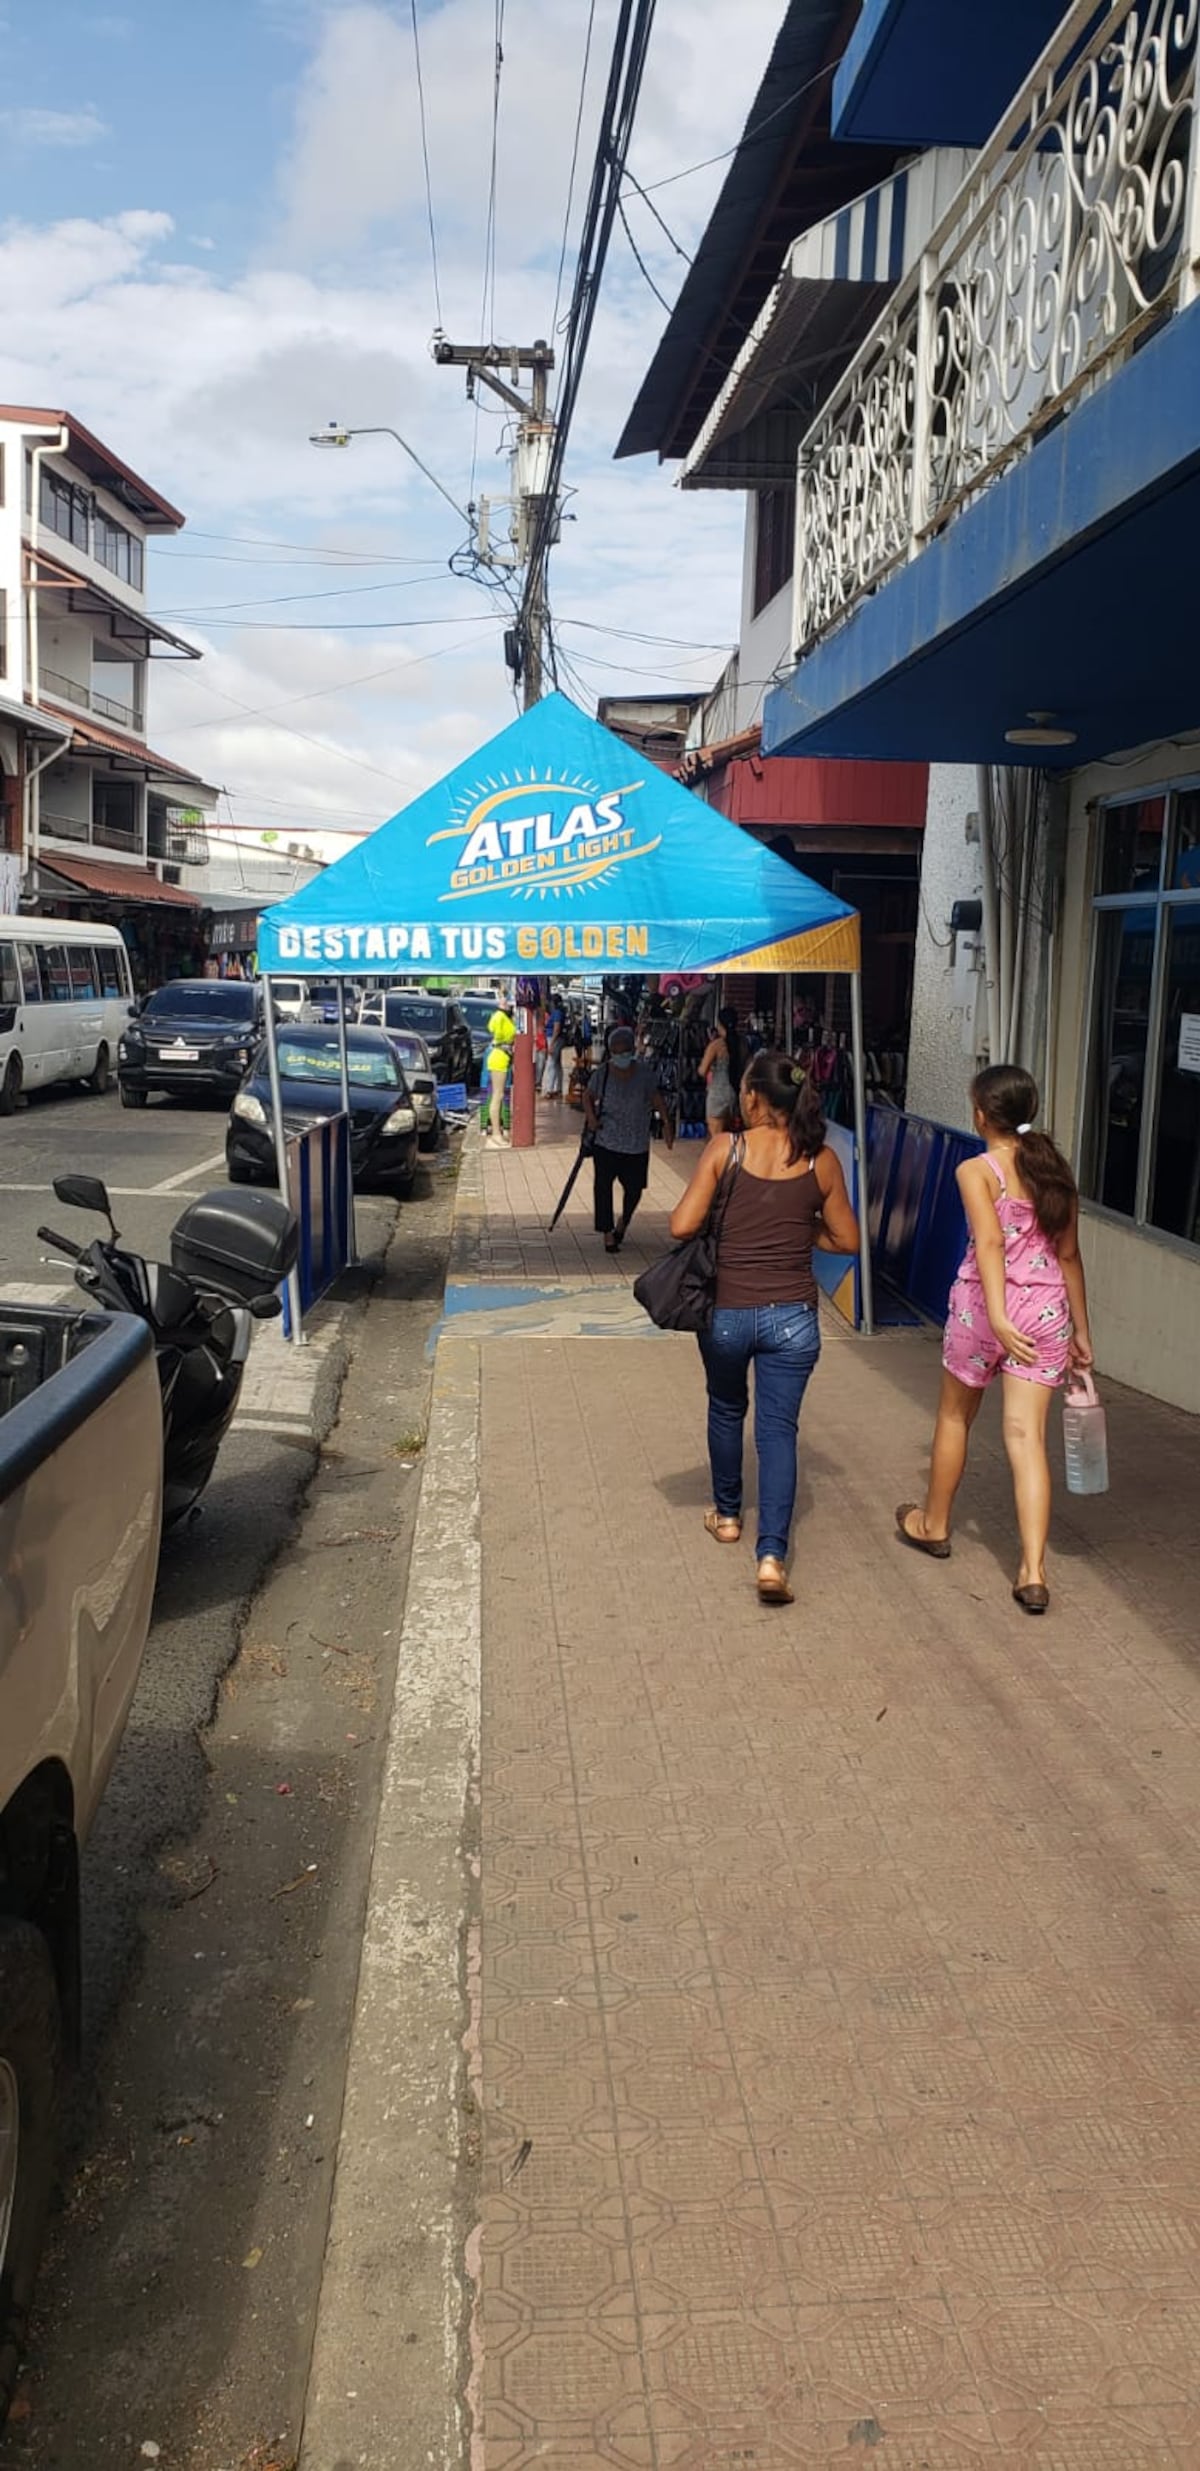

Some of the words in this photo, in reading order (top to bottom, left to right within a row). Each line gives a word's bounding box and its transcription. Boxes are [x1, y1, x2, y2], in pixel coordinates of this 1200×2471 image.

[451, 851, 555, 889] GOLDEN
[563, 828, 635, 863] LIGHT
[457, 794, 624, 868] ATLAS
[278, 926, 432, 960] DESTAPA
[440, 926, 506, 959] TUS
[516, 926, 649, 960] GOLDEN
